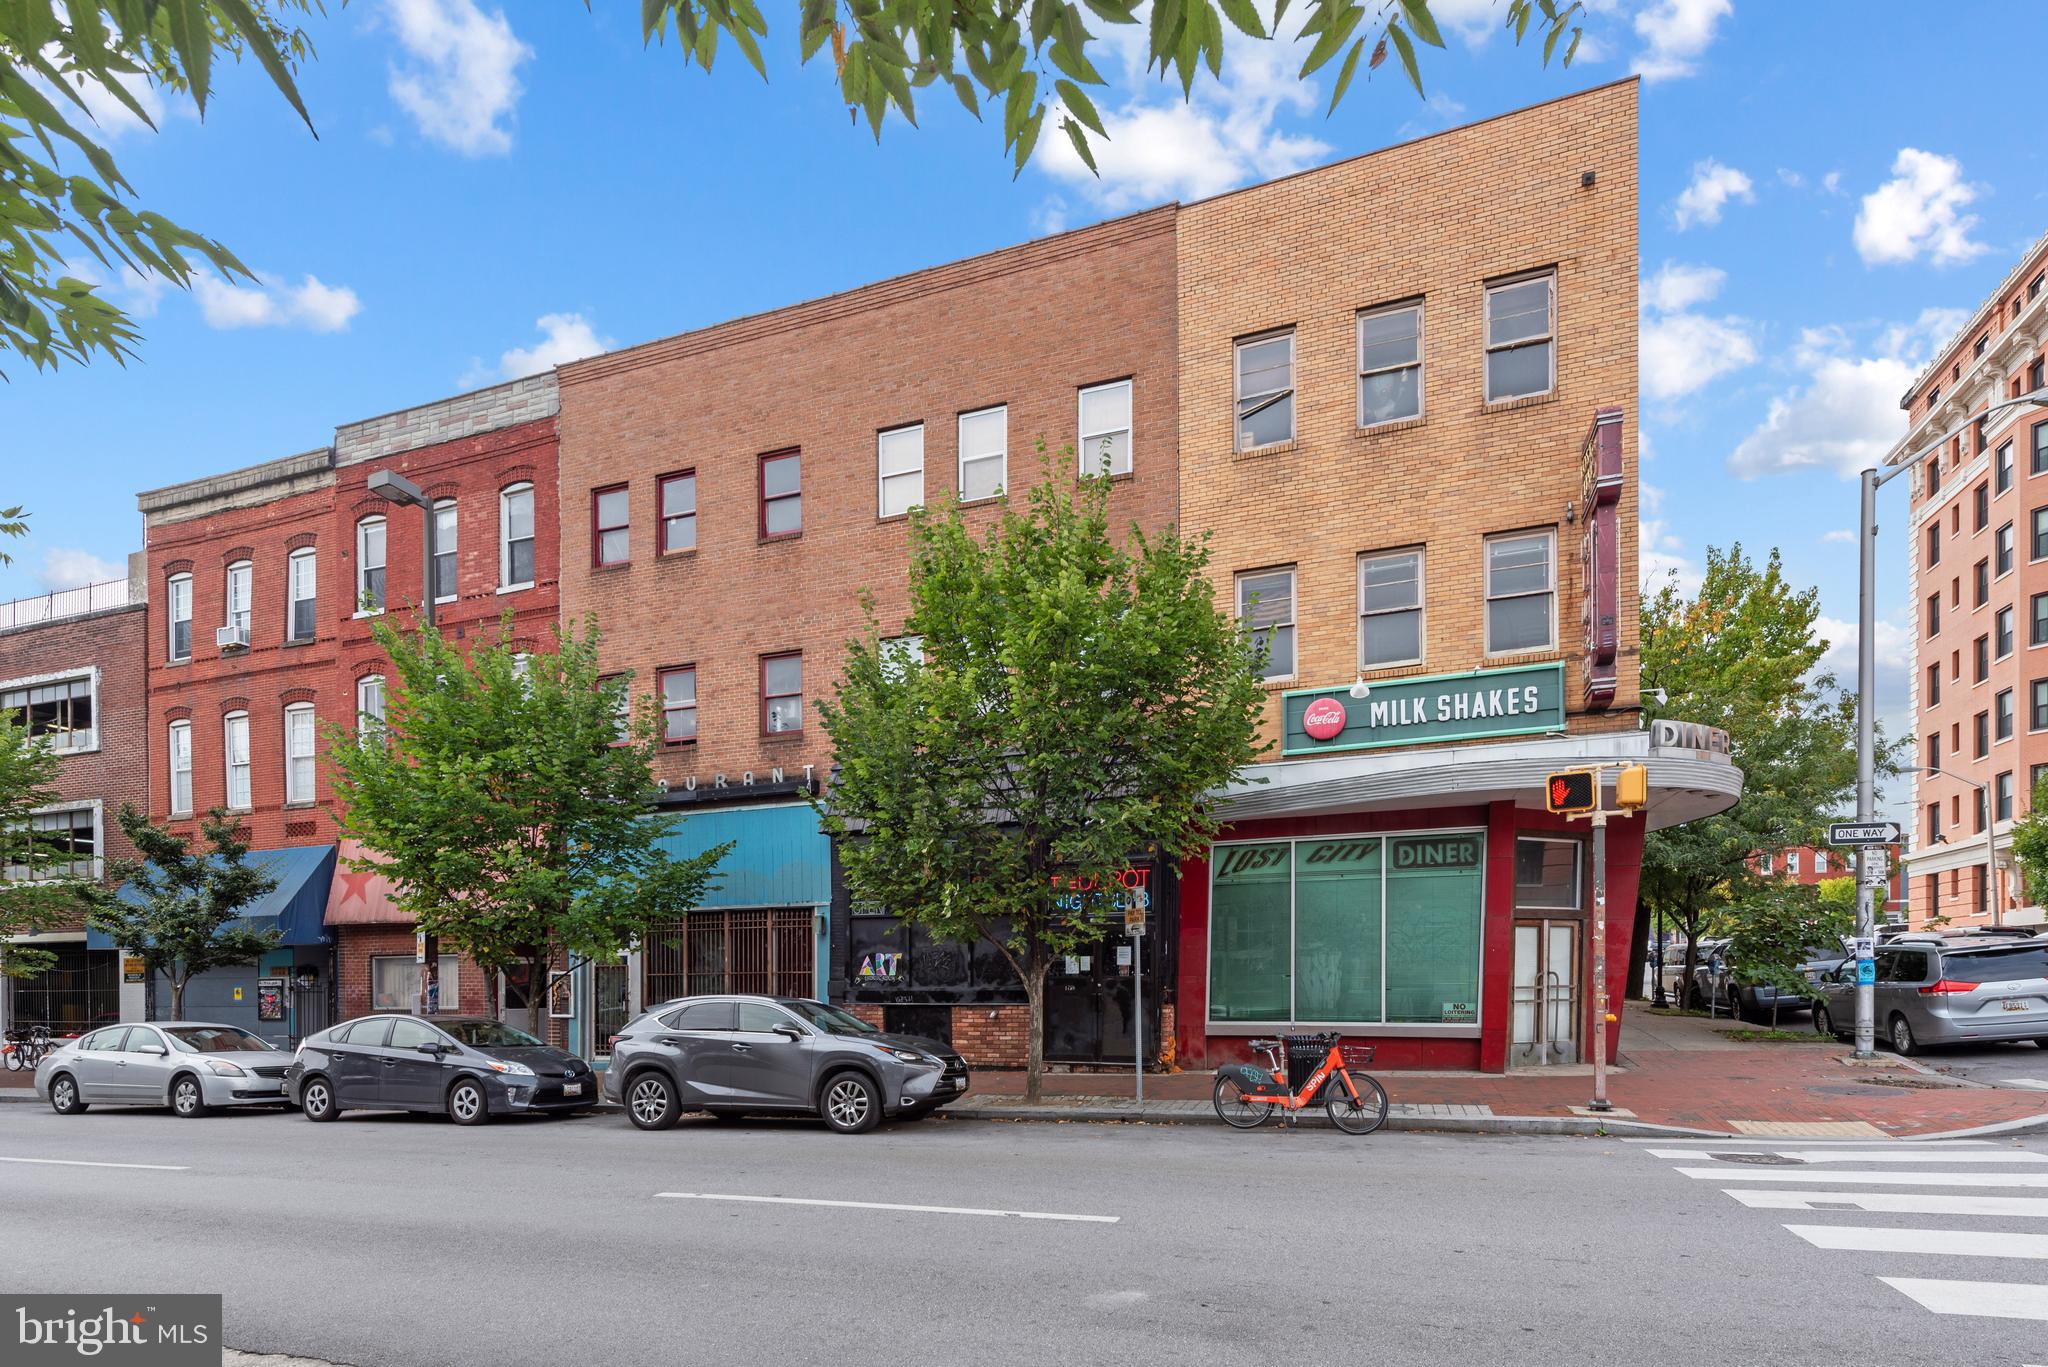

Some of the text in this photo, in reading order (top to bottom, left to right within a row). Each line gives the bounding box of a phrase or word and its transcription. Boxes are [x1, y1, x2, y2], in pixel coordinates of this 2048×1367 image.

[1370, 686, 1538, 729] MILK SHAKES
[1659, 721, 1730, 755] DINER
[1838, 828, 1885, 838] ONE WAY
[1216, 841, 1473, 880] LOST CITY DINER
[1078, 868, 1151, 891] DPOT
[860, 953, 903, 976] ART
[1306, 1072, 1326, 1092] SPIN
